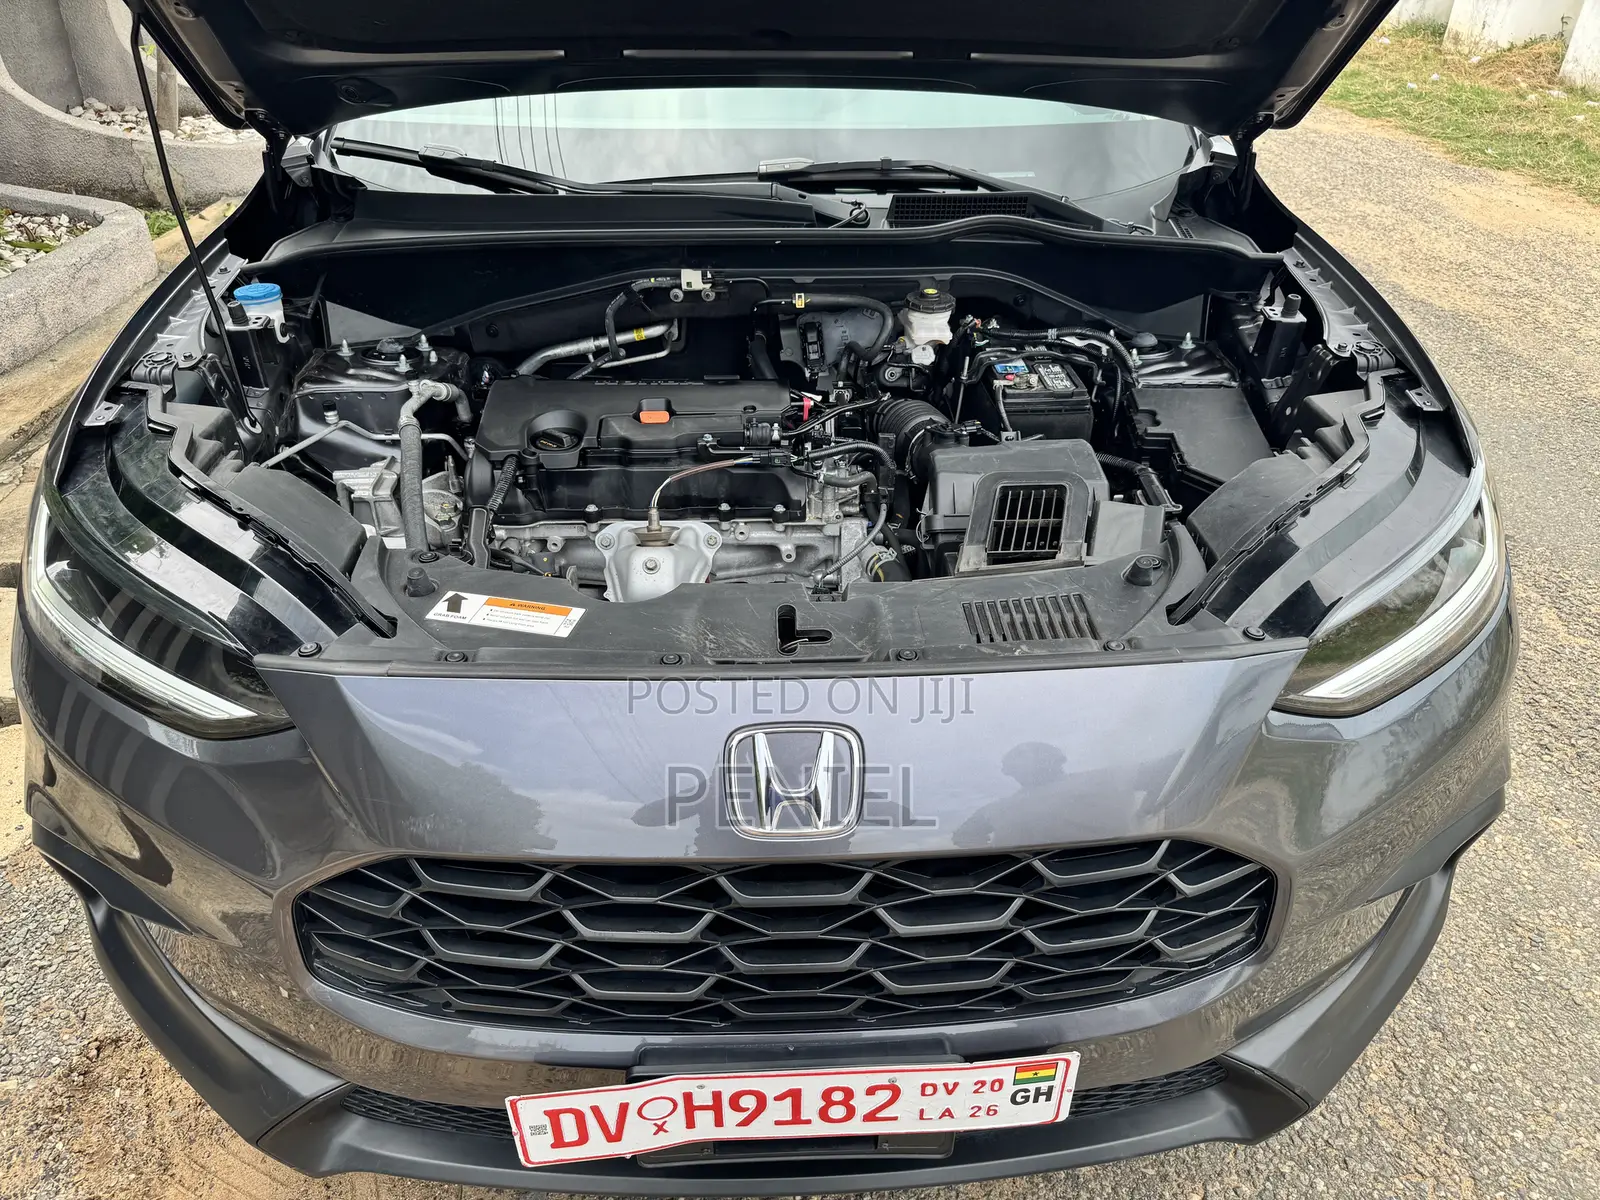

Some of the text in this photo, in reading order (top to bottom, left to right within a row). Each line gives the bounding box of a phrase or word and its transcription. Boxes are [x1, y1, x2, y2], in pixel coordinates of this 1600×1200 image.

[517, 603, 546, 611] WARNING
[920, 1078, 1005, 1097] DV 20
[1009, 1085, 1054, 1106] GH
[918, 1104, 999, 1121] LA 26
